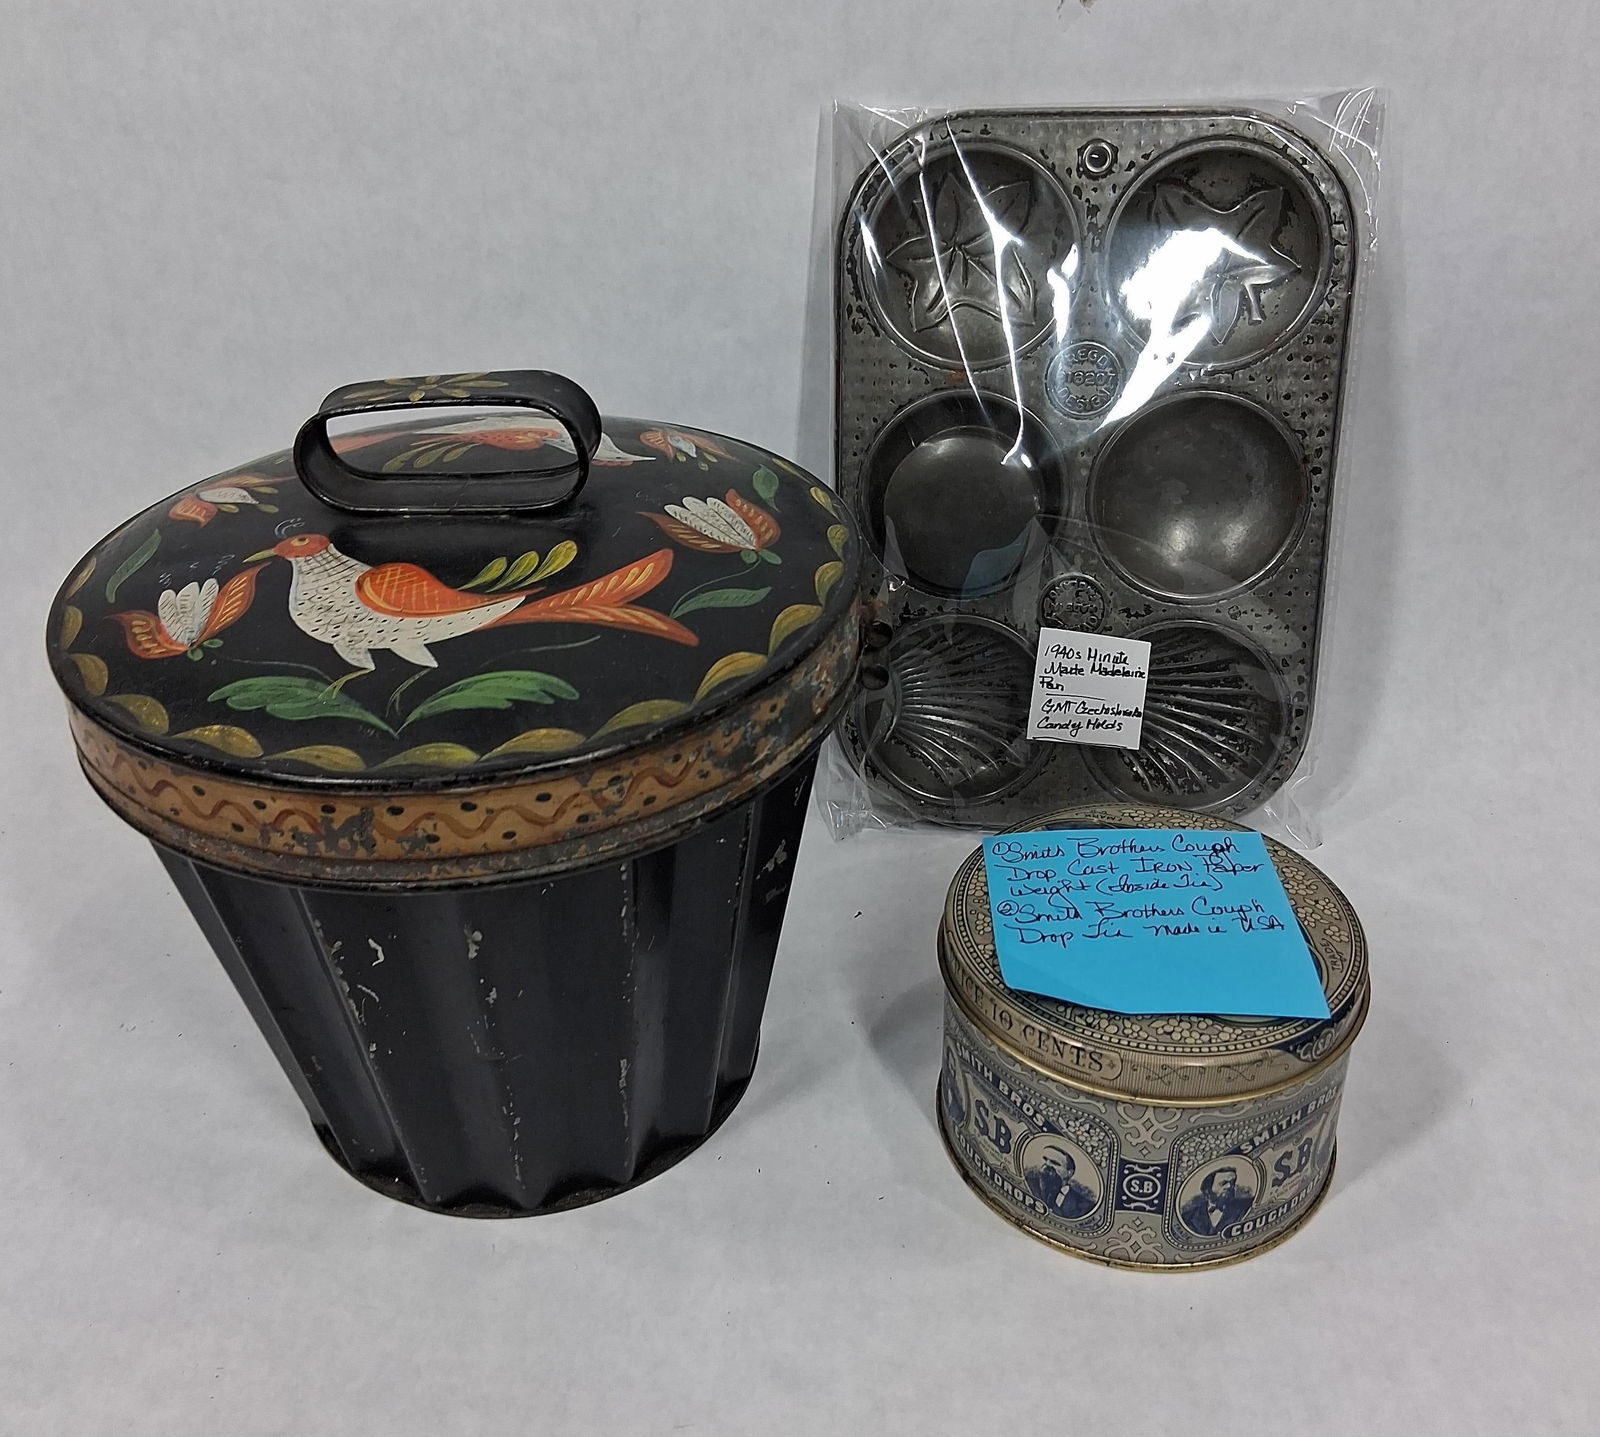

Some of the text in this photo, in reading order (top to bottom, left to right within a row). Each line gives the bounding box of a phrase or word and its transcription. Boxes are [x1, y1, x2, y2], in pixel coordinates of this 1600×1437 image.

[1044, 643, 1130, 666] 1940s Minute
[1038, 675, 1064, 692] Pan
[1036, 716, 1083, 737] Candy
[994, 864, 1057, 882] Drop
[1067, 858, 1120, 876] Cast
[1193, 854, 1264, 876] Paper
[1085, 900, 1185, 920] Brothers
[1003, 923, 1074, 948] Drop
[1231, 914, 1285, 933] USA
[1022, 1024, 1104, 1073] CENTS
[1239, 1109, 1302, 1154] SMITH
[954, 1124, 991, 1178] COUGH
[994, 1172, 1046, 1215] DROPS
[1129, 1179, 1154, 1194] S.B
[1230, 1205, 1288, 1237] COUGH
